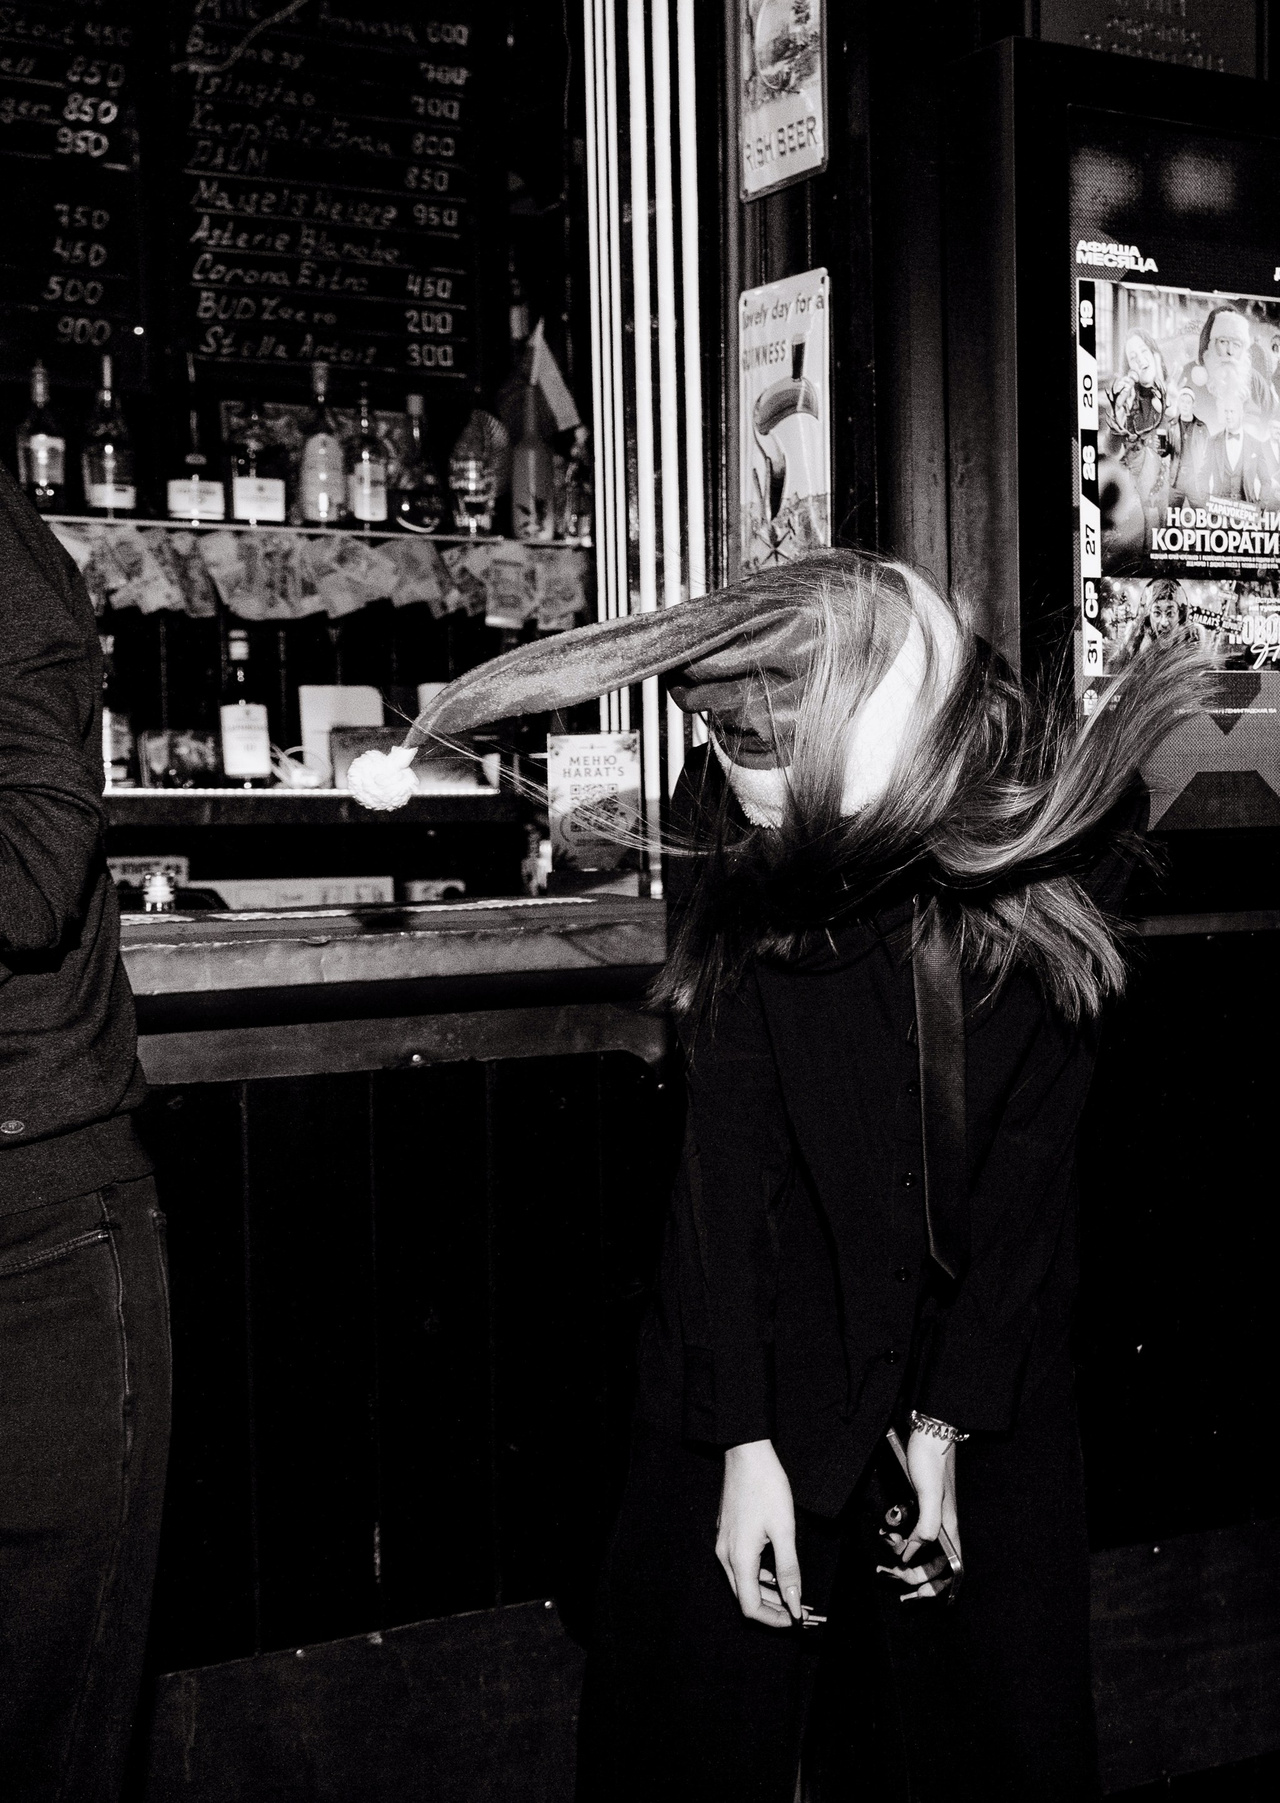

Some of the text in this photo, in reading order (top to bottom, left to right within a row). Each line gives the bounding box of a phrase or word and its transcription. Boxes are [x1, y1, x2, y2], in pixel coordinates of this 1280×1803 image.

[66, 55, 126, 88] 850
[62, 92, 119, 124] 850
[410, 94, 460, 121] 700
[55, 126, 109, 158] 950
[411, 131, 456, 157] 800
[777, 116, 818, 156] BEER
[404, 166, 450, 191] 850
[53, 203, 110, 230] 750
[412, 203, 459, 228] 950
[53, 236, 108, 268] 450
[1076, 251, 1158, 272] МЕСЯЦА
[1077, 240, 1140, 257] АФИША
[191, 252, 290, 287] Corona
[405, 273, 453, 299] 450
[41, 275, 104, 305] 500
[196, 290, 256, 320] BUD
[405, 309, 453, 334] 200
[56, 315, 111, 347] 900
[406, 343, 454, 367] 300
[1083, 374, 1094, 409] 20
[1085, 524, 1096, 556] 27
[1087, 640, 1098, 664] 31
[562, 766, 624, 778] HARAT'S
[569, 754, 617, 767] МЕНЮ
